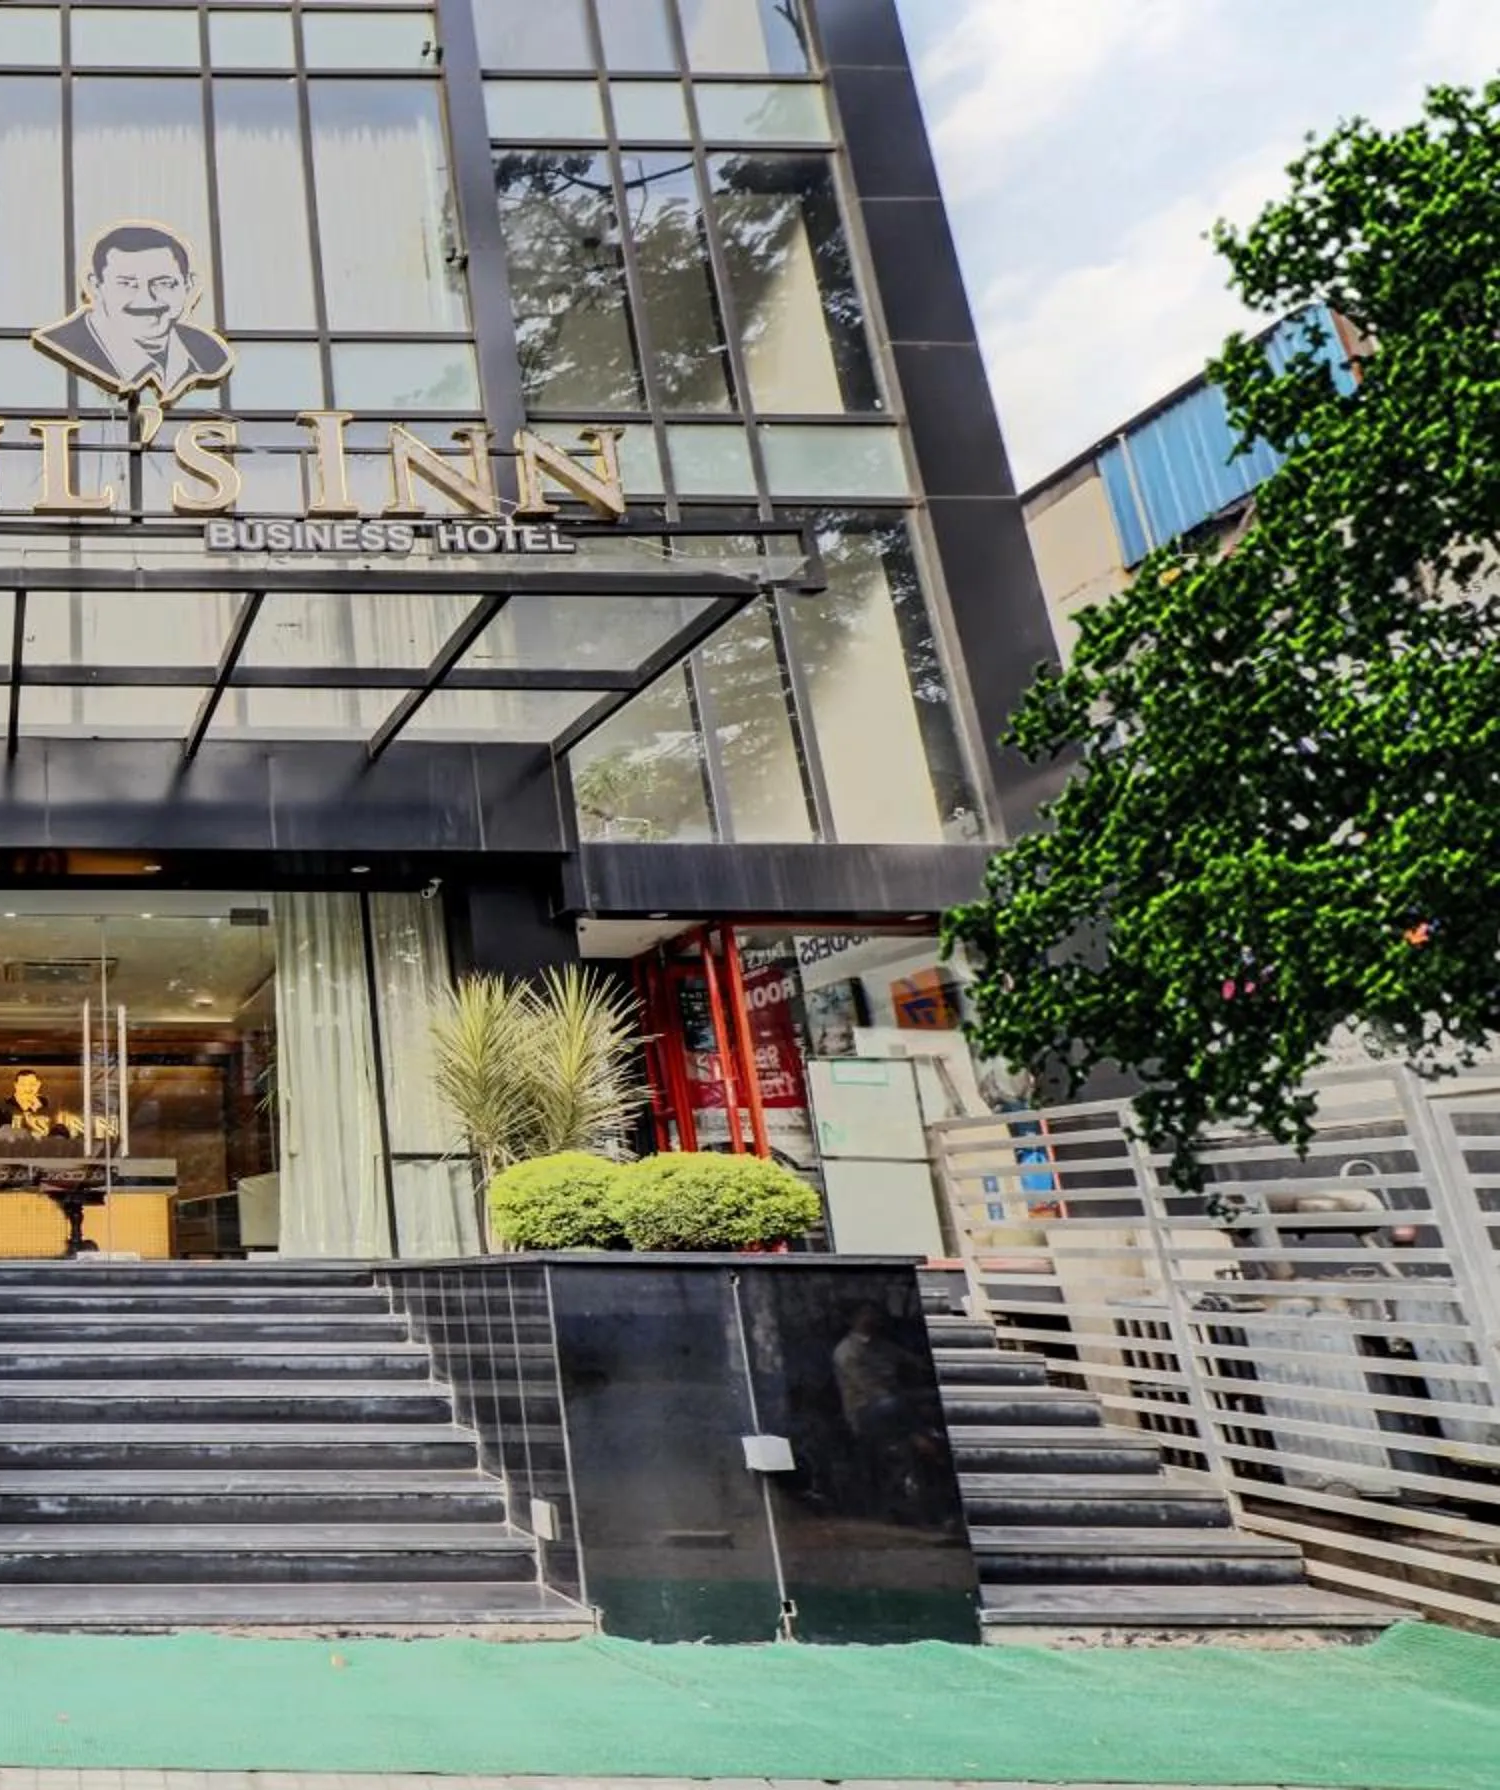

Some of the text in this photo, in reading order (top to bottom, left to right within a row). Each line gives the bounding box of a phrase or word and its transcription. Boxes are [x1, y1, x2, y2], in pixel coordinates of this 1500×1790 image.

[296, 410, 626, 521] INN
[204, 521, 578, 554] BUSINESS HOTEL
